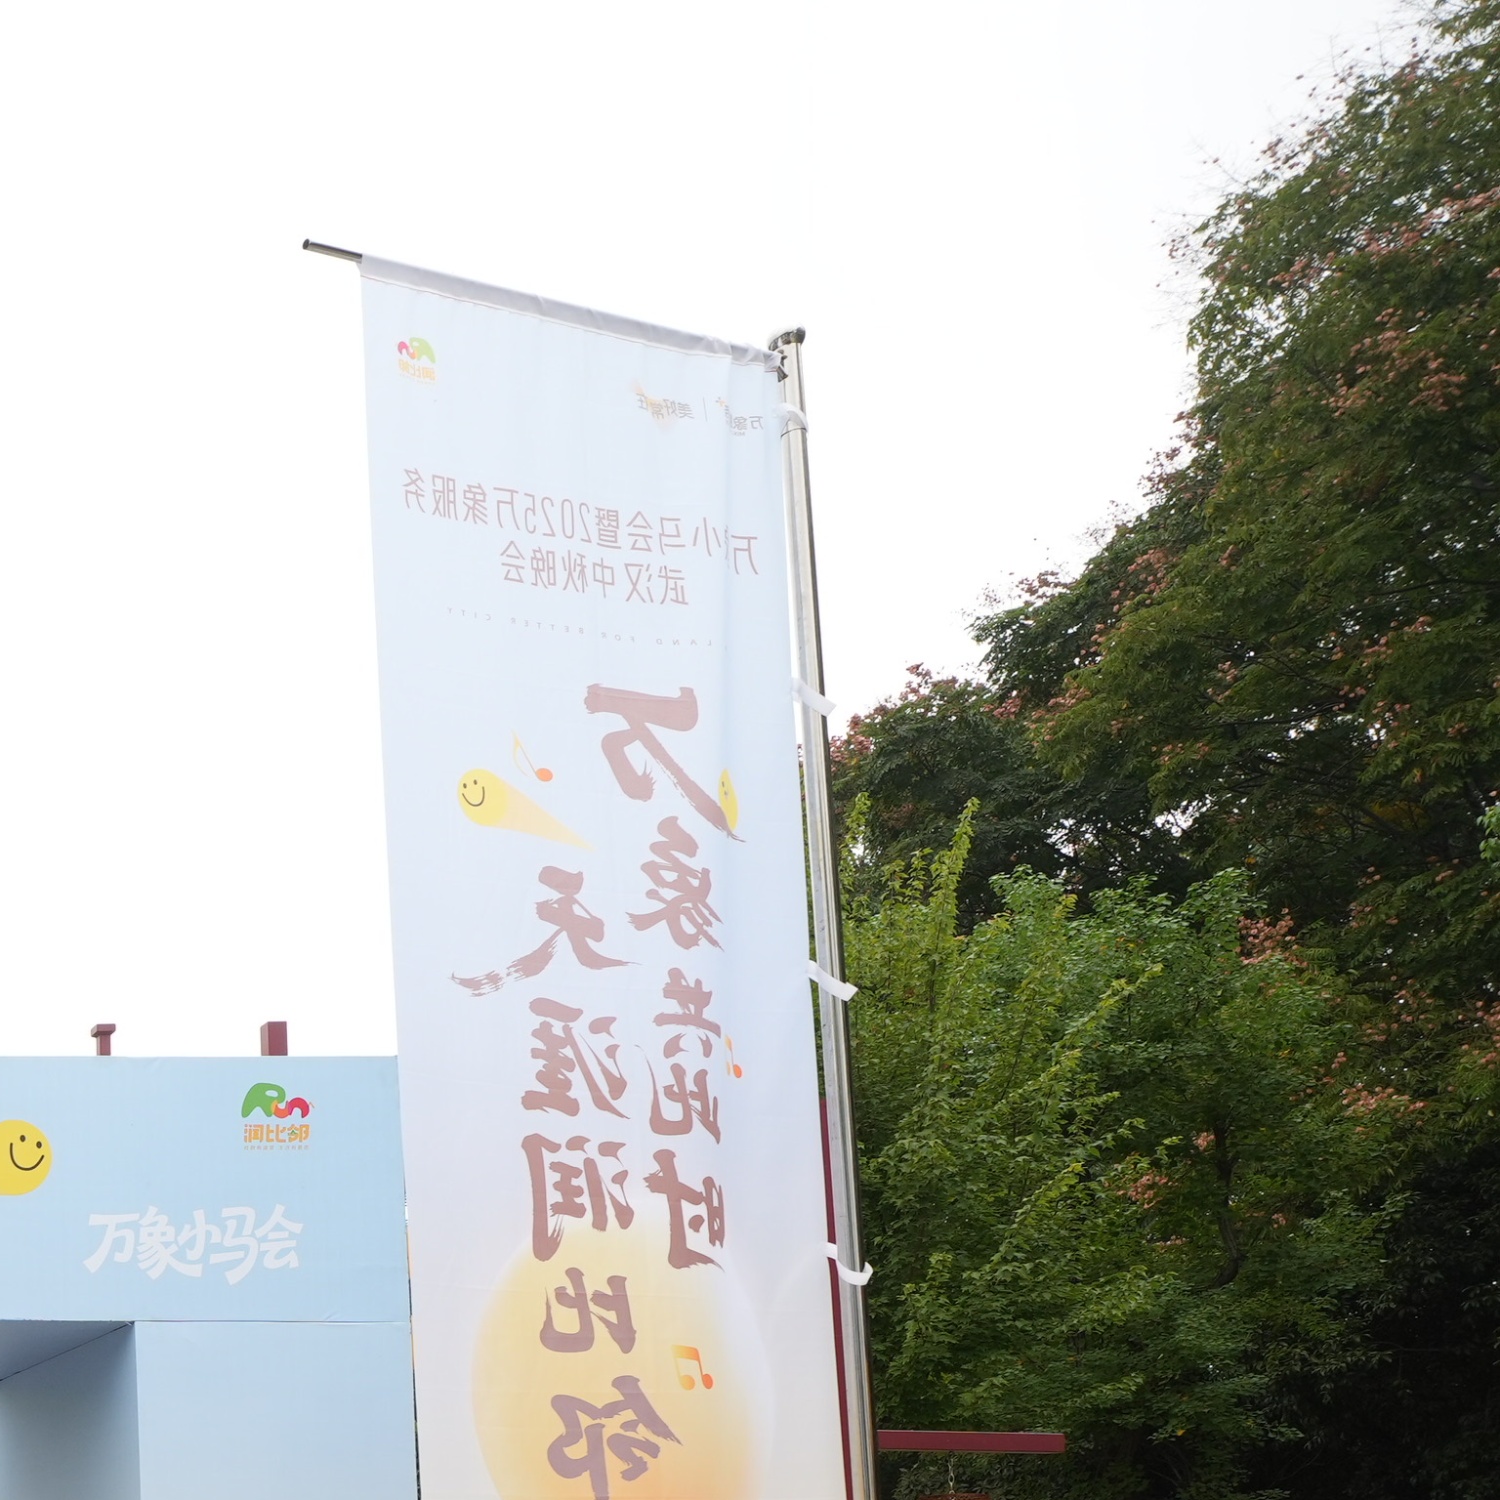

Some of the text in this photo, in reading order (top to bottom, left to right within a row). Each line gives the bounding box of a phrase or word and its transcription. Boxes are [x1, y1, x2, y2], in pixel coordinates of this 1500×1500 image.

[243, 1124, 310, 1143] 润比邻
[83, 1204, 304, 1286] 万象小马会
